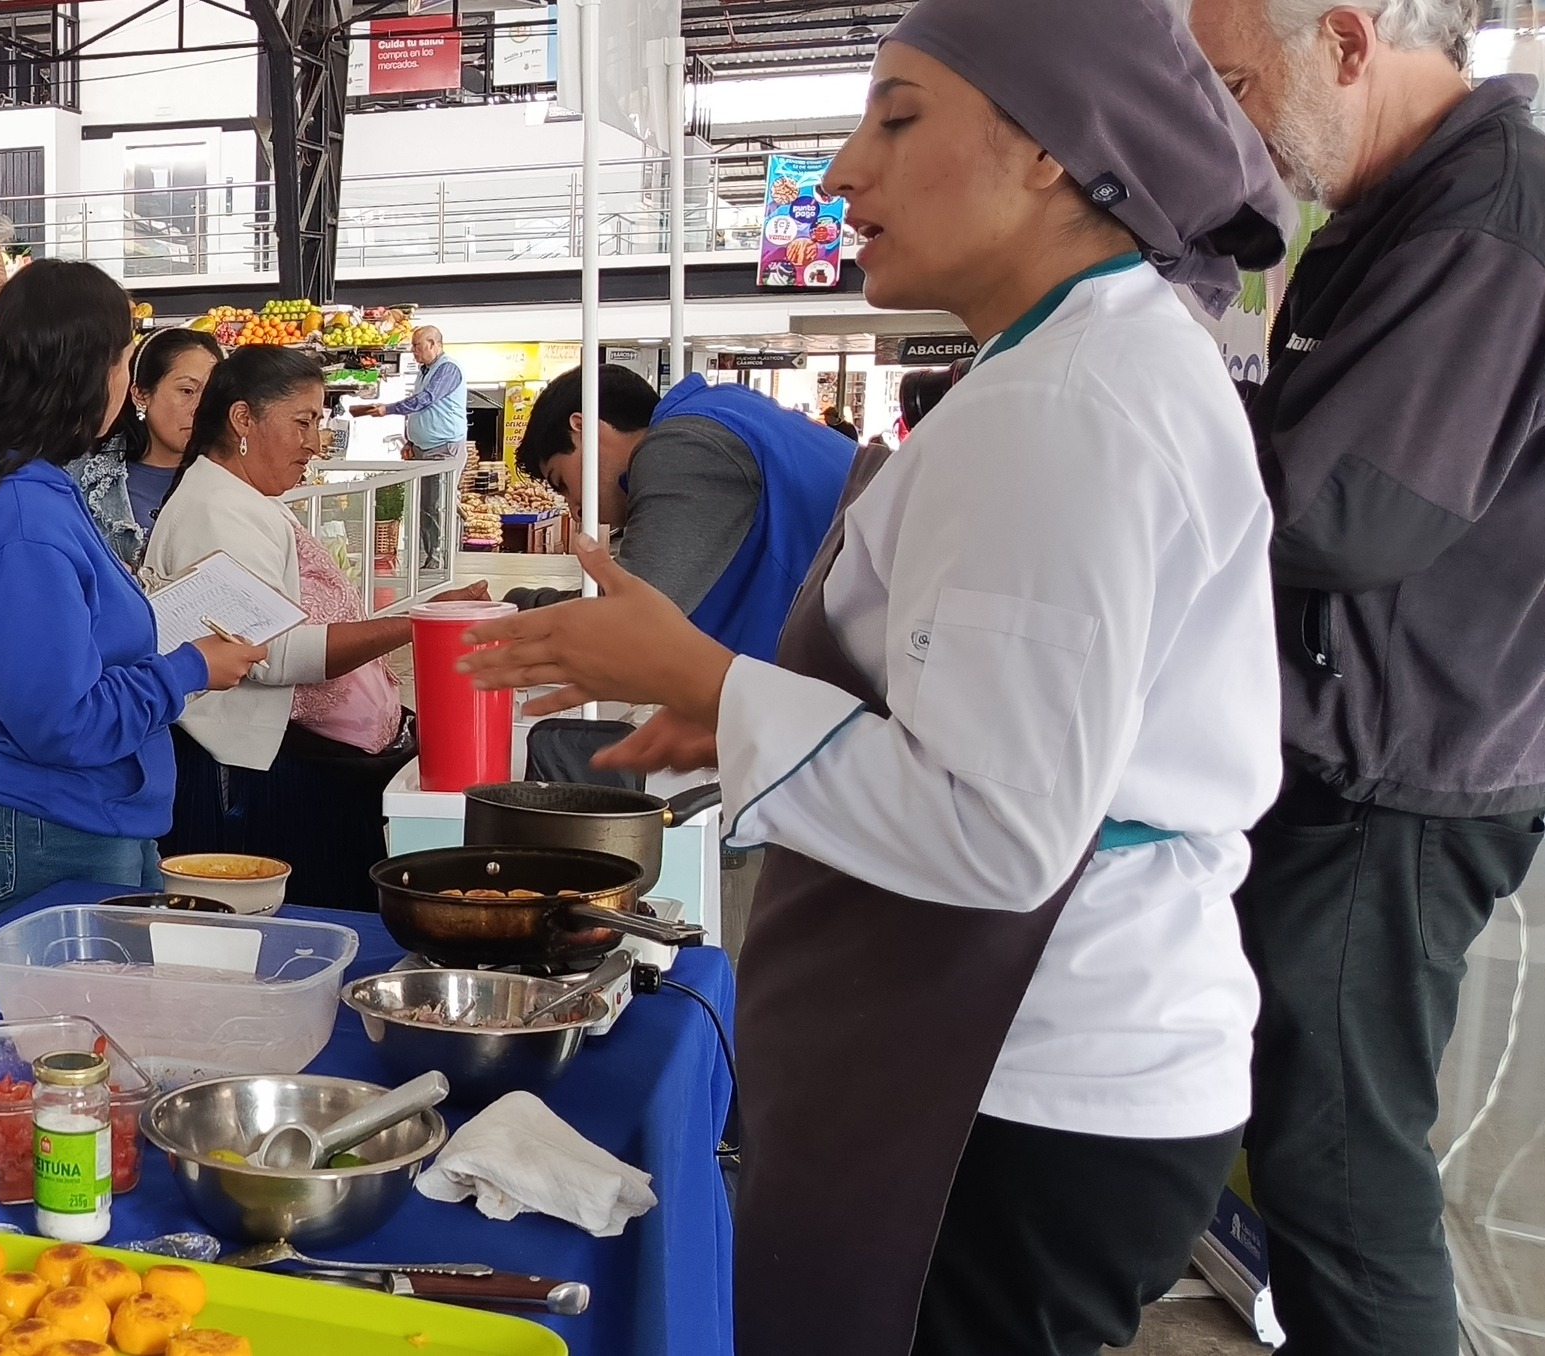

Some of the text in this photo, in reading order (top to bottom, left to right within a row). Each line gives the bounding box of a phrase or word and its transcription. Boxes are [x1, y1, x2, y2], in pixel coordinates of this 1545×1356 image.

[407, 39, 417, 47] tu
[378, 49, 408, 60] compra
[422, 47, 434, 56] los
[378, 60, 419, 70] mercados.
